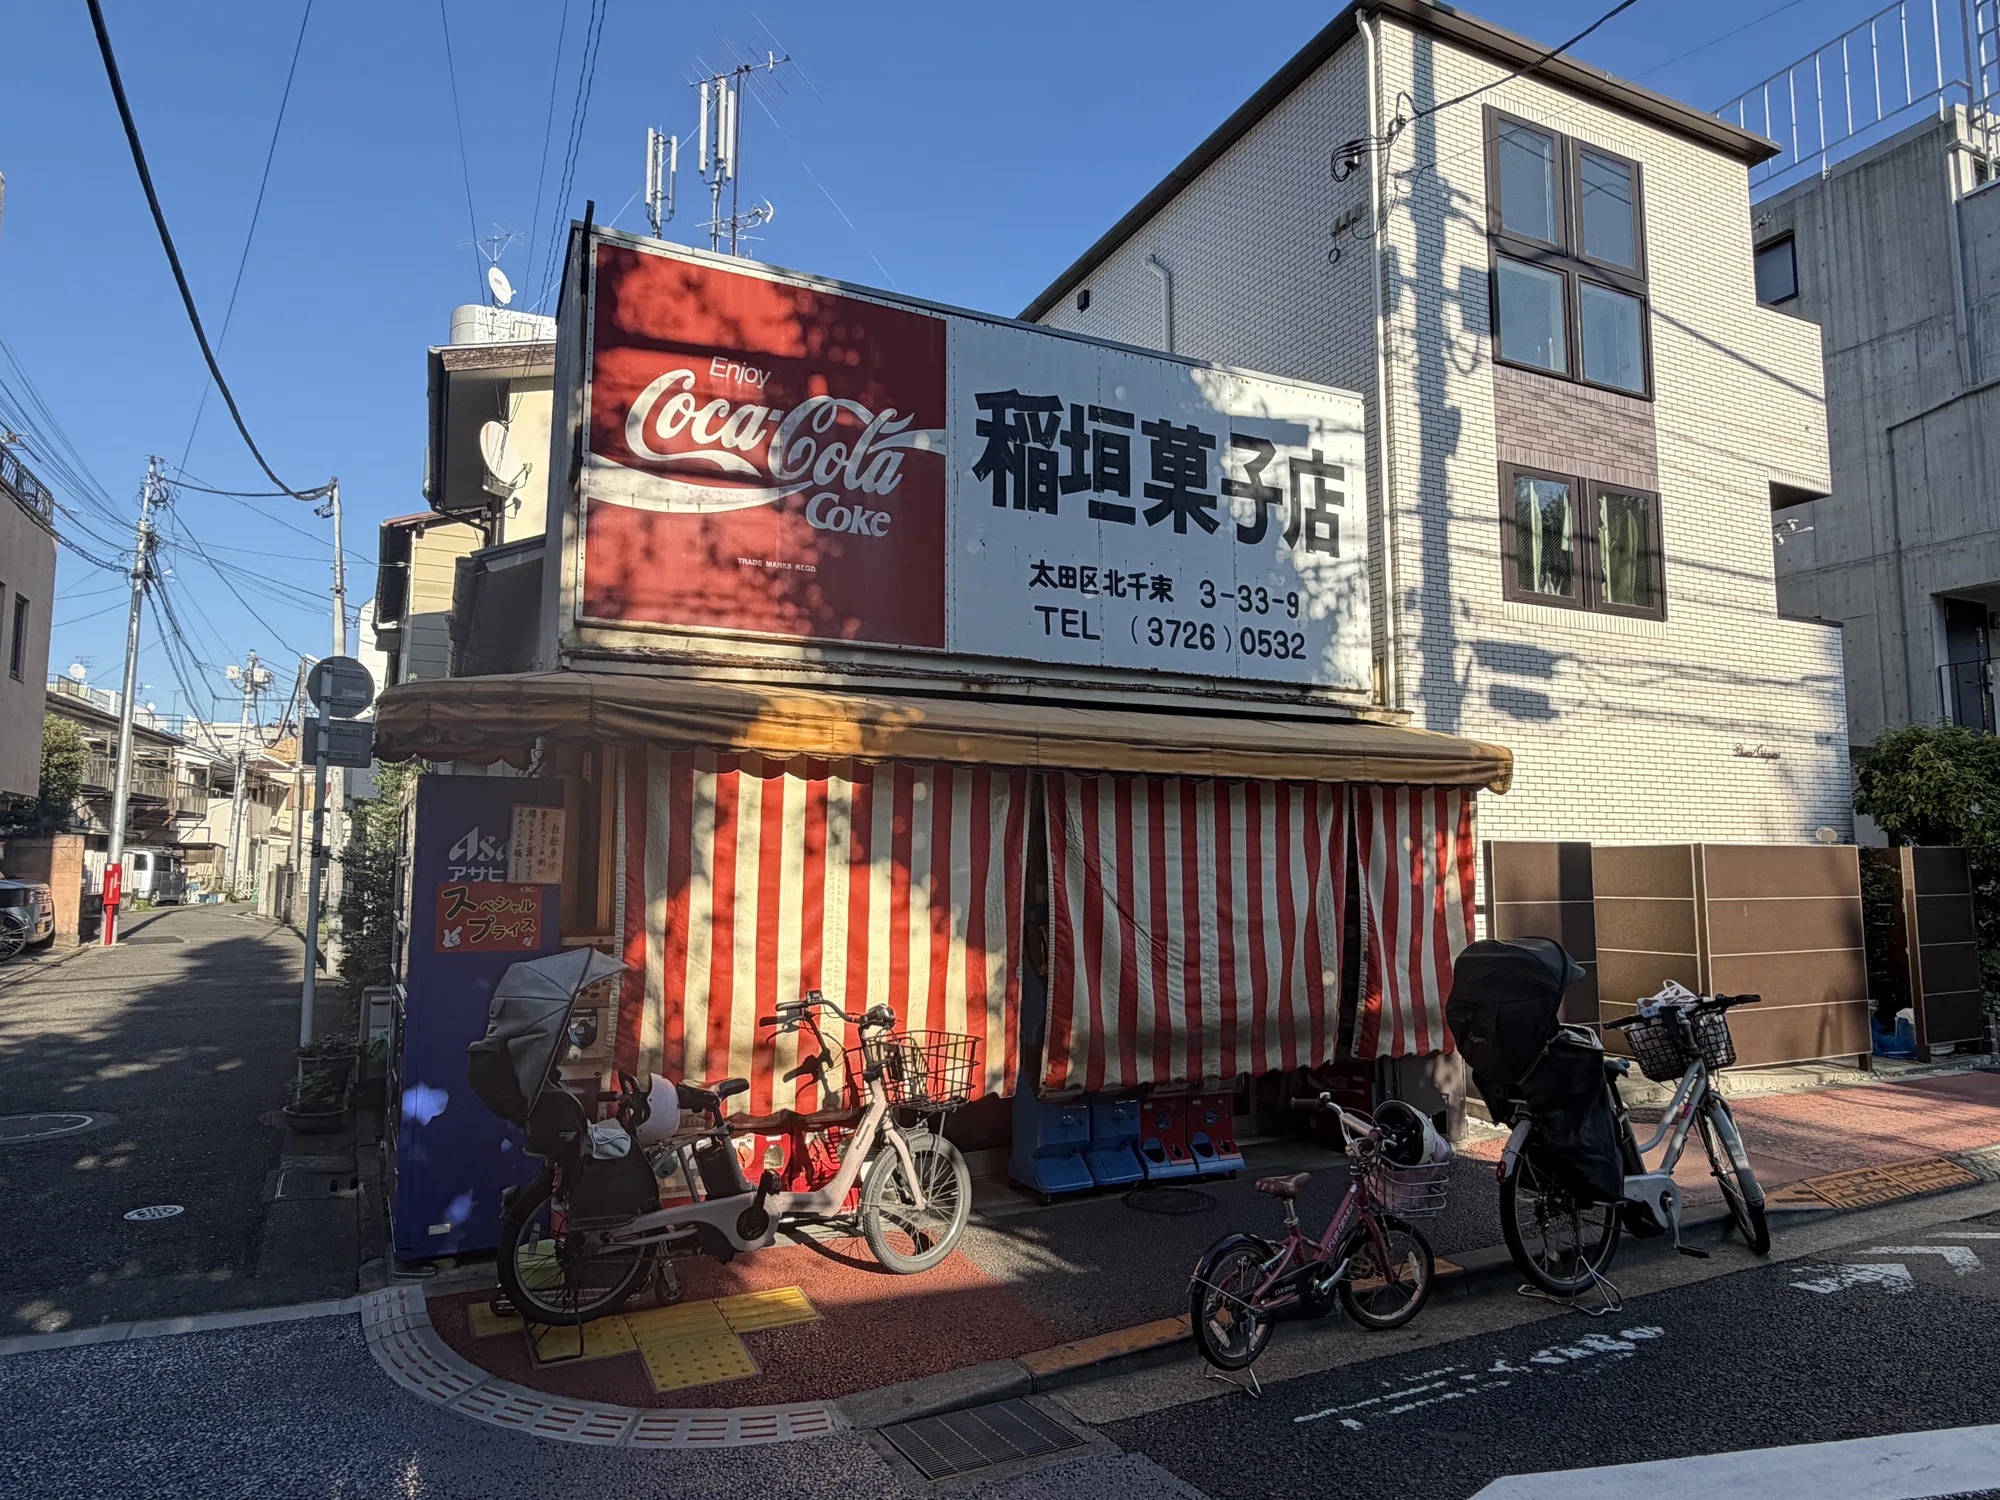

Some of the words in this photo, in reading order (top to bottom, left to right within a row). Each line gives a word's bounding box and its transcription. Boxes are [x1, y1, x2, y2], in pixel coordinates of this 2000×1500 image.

[709, 356, 771, 388] Enjoy
[625, 369, 916, 496] Coca-Cola
[971, 388, 1345, 558] 稲垣菓子店
[805, 491, 892, 538] Coke
[737, 557, 762, 567] TRADE
[766, 559, 792, 571] MARKS
[1199, 580, 1300, 620] 3-33-9
[1034, 605, 1101, 641] TEL
[448, 866, 504, 882] アサヒ
[441, 886, 536, 919] スペシャル
[467, 916, 536, 943] プライス
